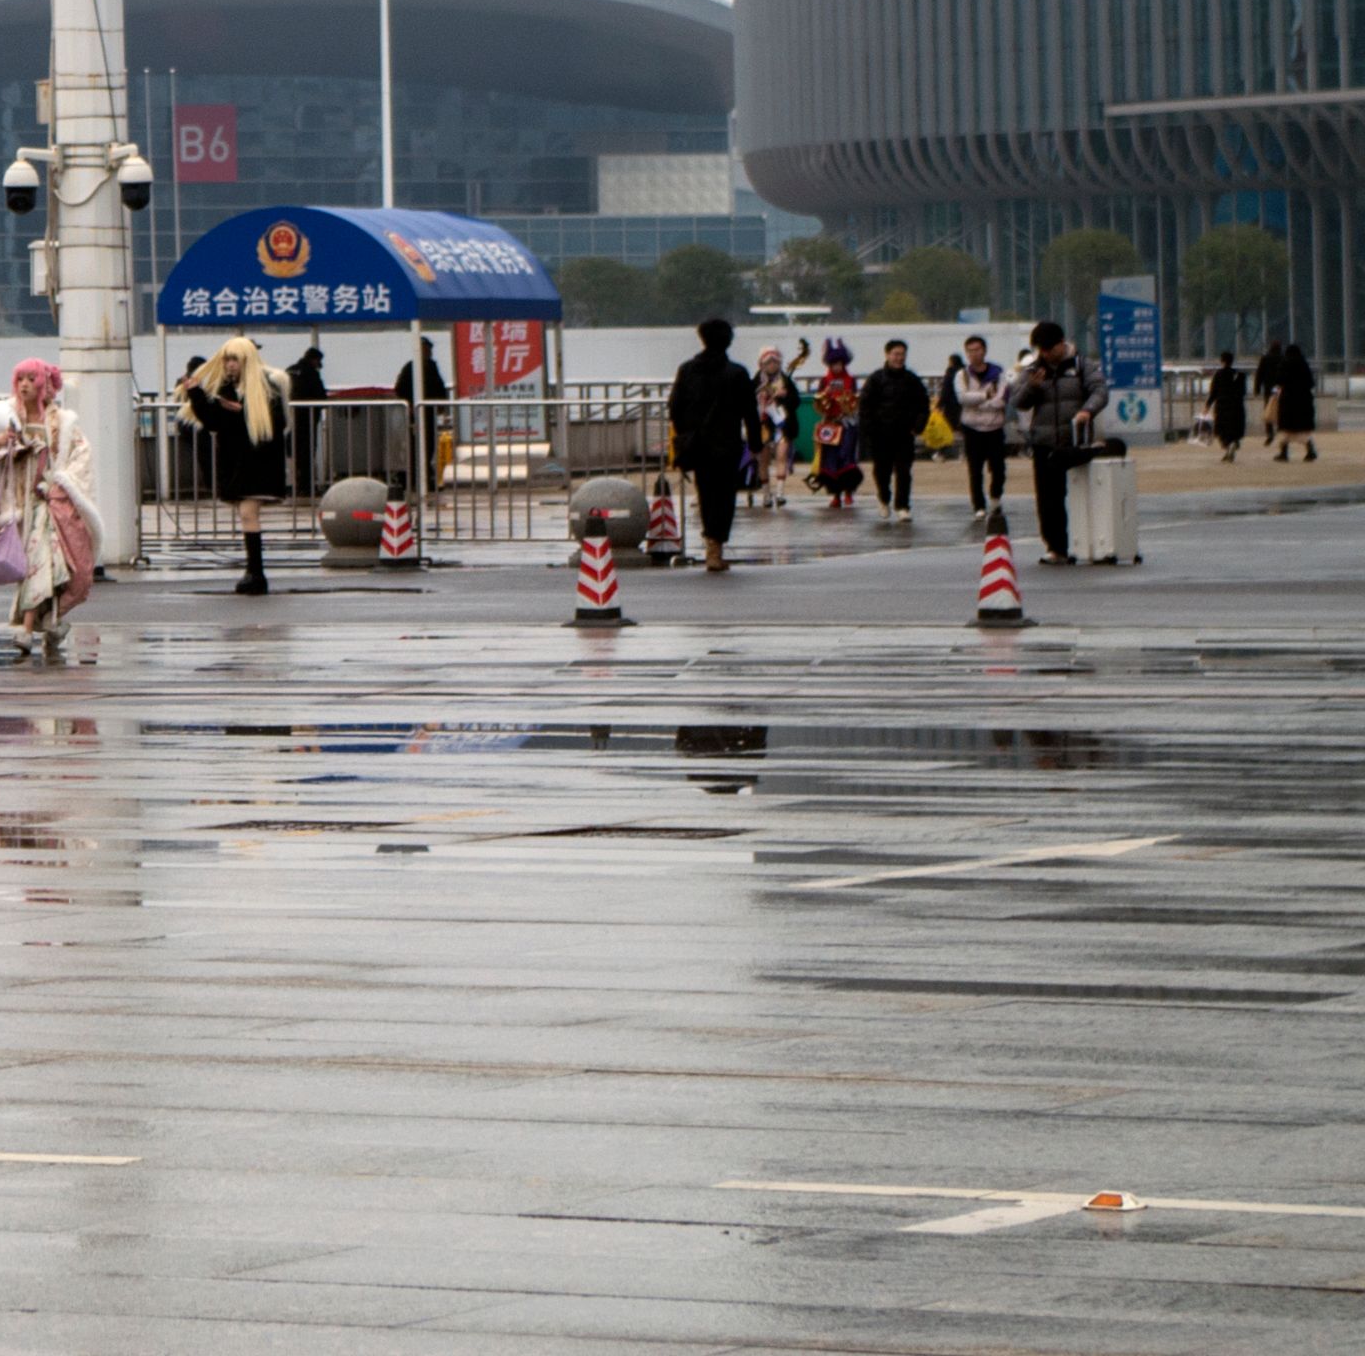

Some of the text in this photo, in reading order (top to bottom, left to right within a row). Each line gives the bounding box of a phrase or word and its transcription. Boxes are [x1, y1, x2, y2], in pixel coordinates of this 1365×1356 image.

[180, 125, 229, 163] B6
[182, 283, 391, 317] 综合治安警务站
